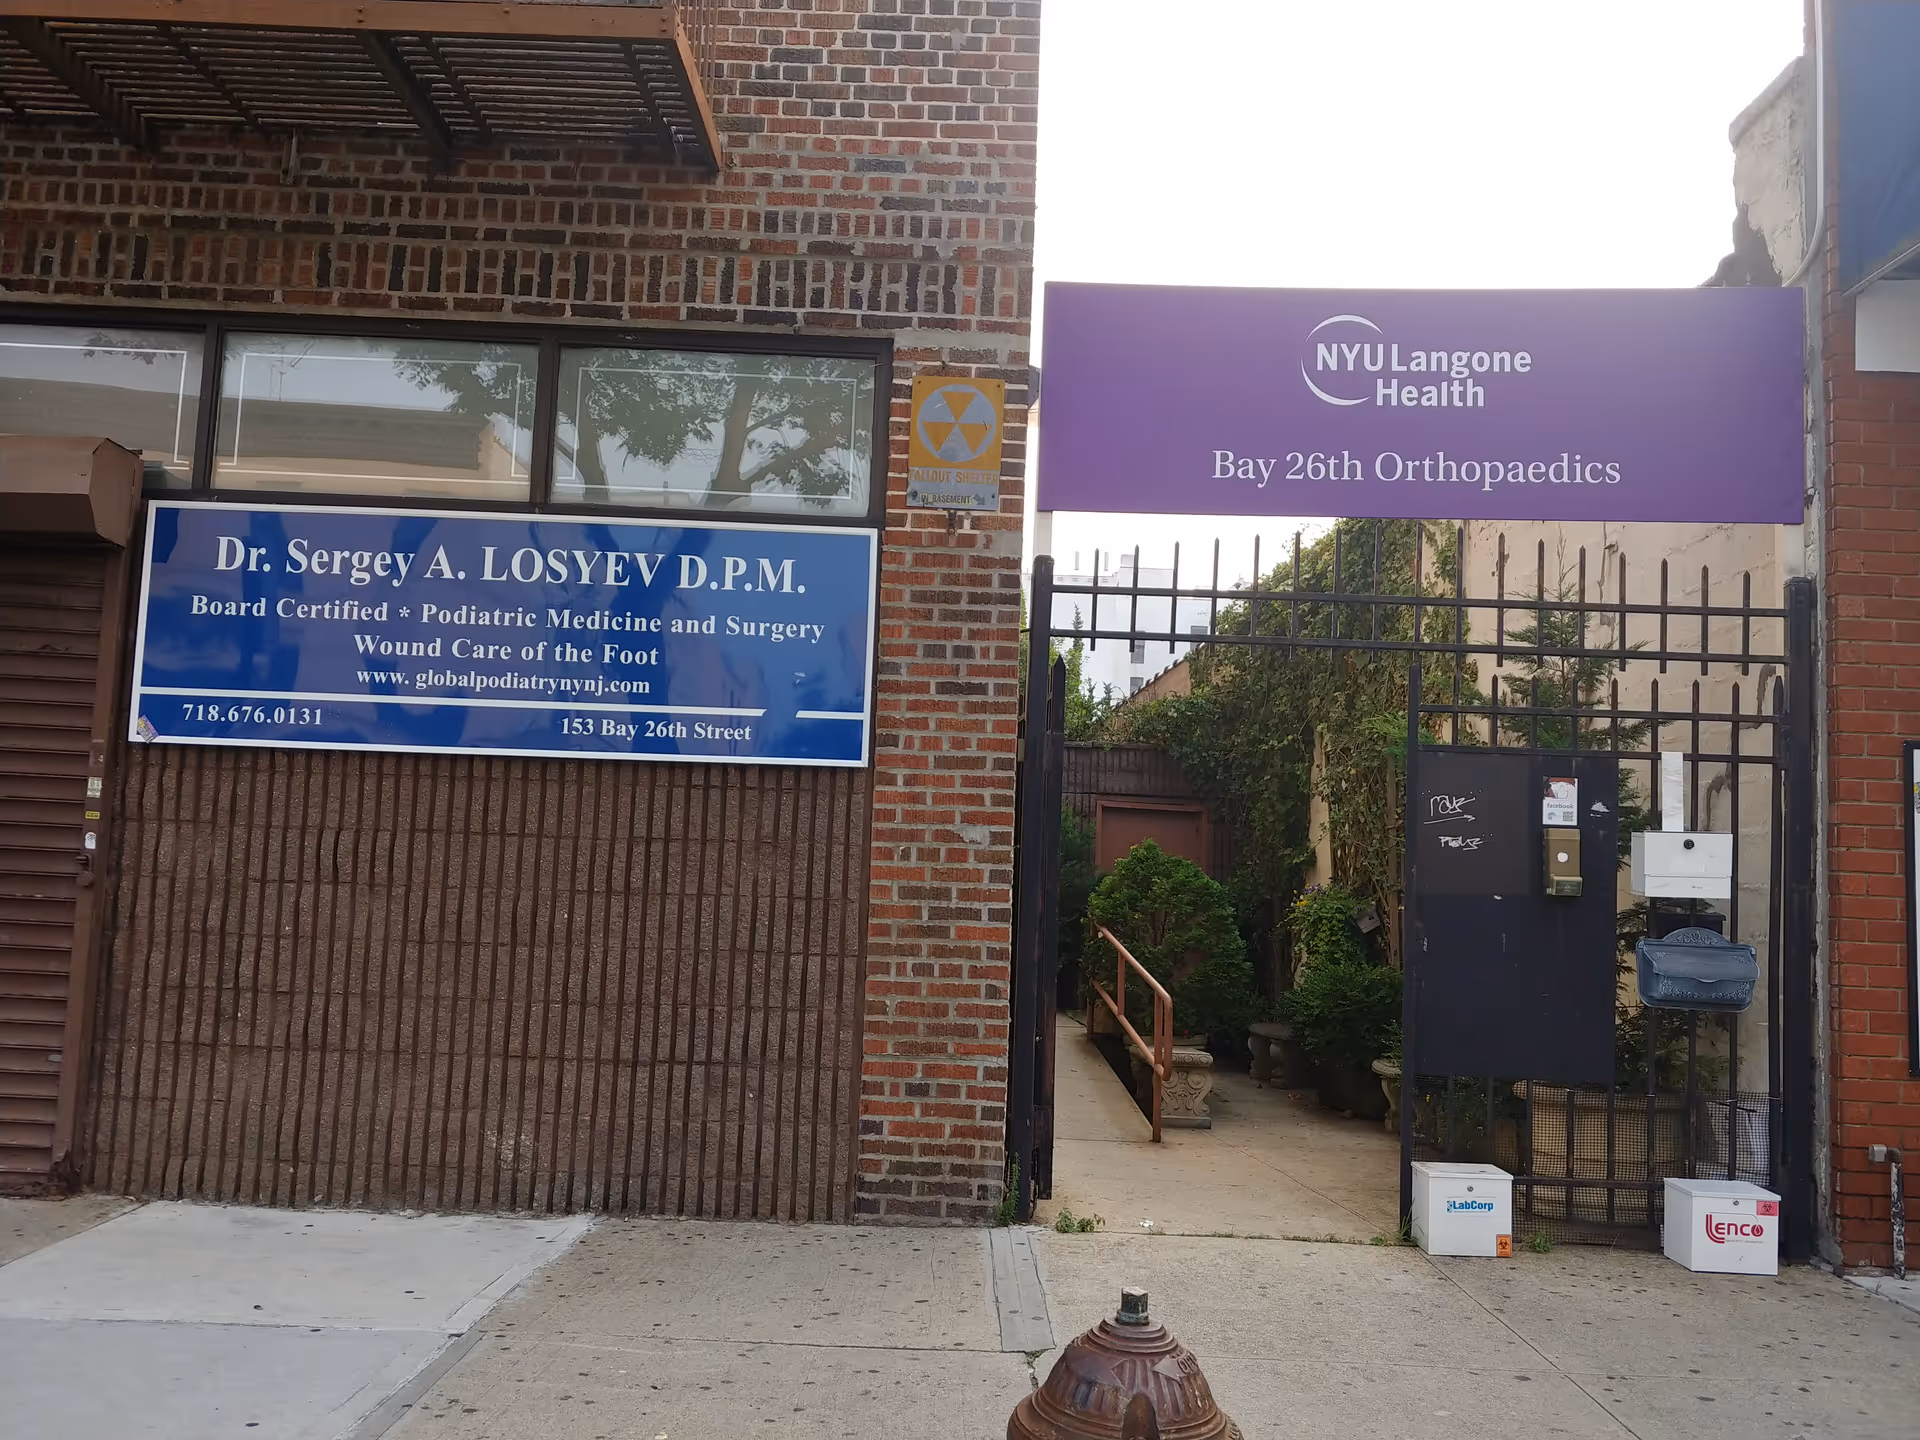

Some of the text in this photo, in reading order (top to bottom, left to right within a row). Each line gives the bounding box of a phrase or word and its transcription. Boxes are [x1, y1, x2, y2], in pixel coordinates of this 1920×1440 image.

[1316, 342, 1532, 378] NYU Langone
[1376, 378, 1485, 407] Health
[909, 469, 998, 485] FALLOUT SHELTER
[1212, 450, 1621, 491] Bay 26th Orthopaedics
[932, 494, 970, 504] BASEMENT
[214, 536, 806, 594] Dr. Sergey A. LOSYEV D.P.M.
[191, 595, 825, 643] Board Certified Podiatric Medicine and Surgery
[354, 634, 659, 665] Wound Care of the Foot
[356, 669, 650, 696] www. globalpodiatrynynj.com
[182, 704, 322, 725] 718.676.0131
[561, 718, 751, 741] 153 Bay 26th Street
[1453, 1200, 1494, 1212] LabCorp
